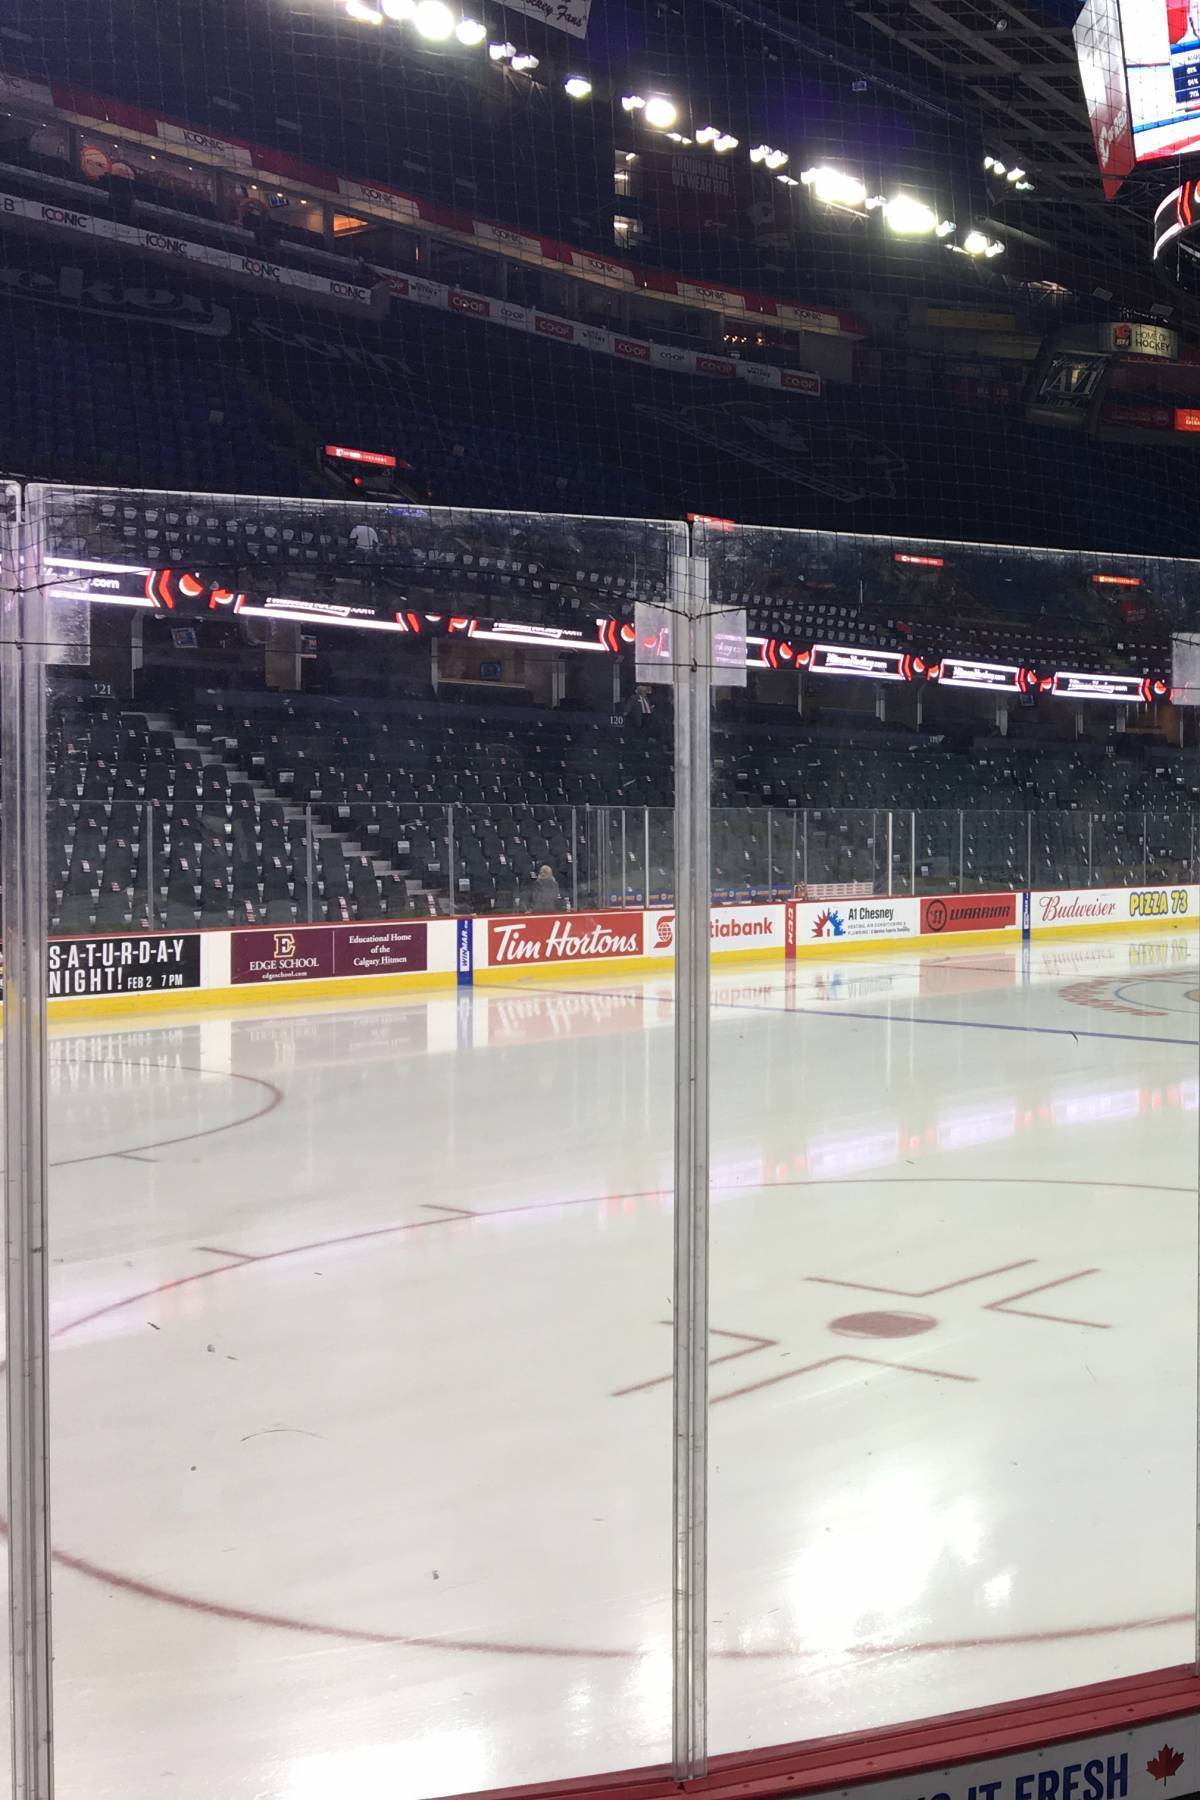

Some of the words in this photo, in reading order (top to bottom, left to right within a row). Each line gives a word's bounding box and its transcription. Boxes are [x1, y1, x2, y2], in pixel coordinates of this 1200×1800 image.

[42, 207, 87, 228] ICONIC
[146, 234, 188, 254] ICONIC
[241, 258, 281, 279] ICONIC
[330, 282, 366, 299] ICONIC
[618, 343, 648, 358] CO-OP
[1135, 338, 1170, 353] HOCKEY
[701, 360, 734, 375] CO-OP
[94, 683, 112, 696] 121
[610, 715, 624, 726] 120
[1040, 895, 1117, 922] Budweiser
[1129, 891, 1168, 916] PIZZA
[1170, 890, 1188, 914] 73
[848, 908, 858, 921] A1
[859, 907, 894, 921] Chesney
[949, 906, 1010, 921] WARRIOR
[709, 917, 773, 939] tiabank
[349, 934, 391, 945] Educational
[392, 933, 412, 943] Home
[494, 923, 540, 962] Tim
[545, 920, 639, 957] Hortons
[49, 939, 185, 971] S-A-T-U-R-D-A-Y
[370, 945, 379, 954] of
[379, 945, 390, 954] the
[249, 960, 277, 970] EDGE
[279, 957, 320, 969] SCHOOL
[353, 957, 379, 968] Calgary
[380, 954, 407, 966] Hitmen
[49, 970, 123, 995] NIGHT!
[128, 976, 144, 989] FEB
[146, 975, 152, 988] 2
[161, 974, 167, 986] 7
[169, 974, 183, 986] PM
[1015, 1752, 1129, 1800] FRESH
